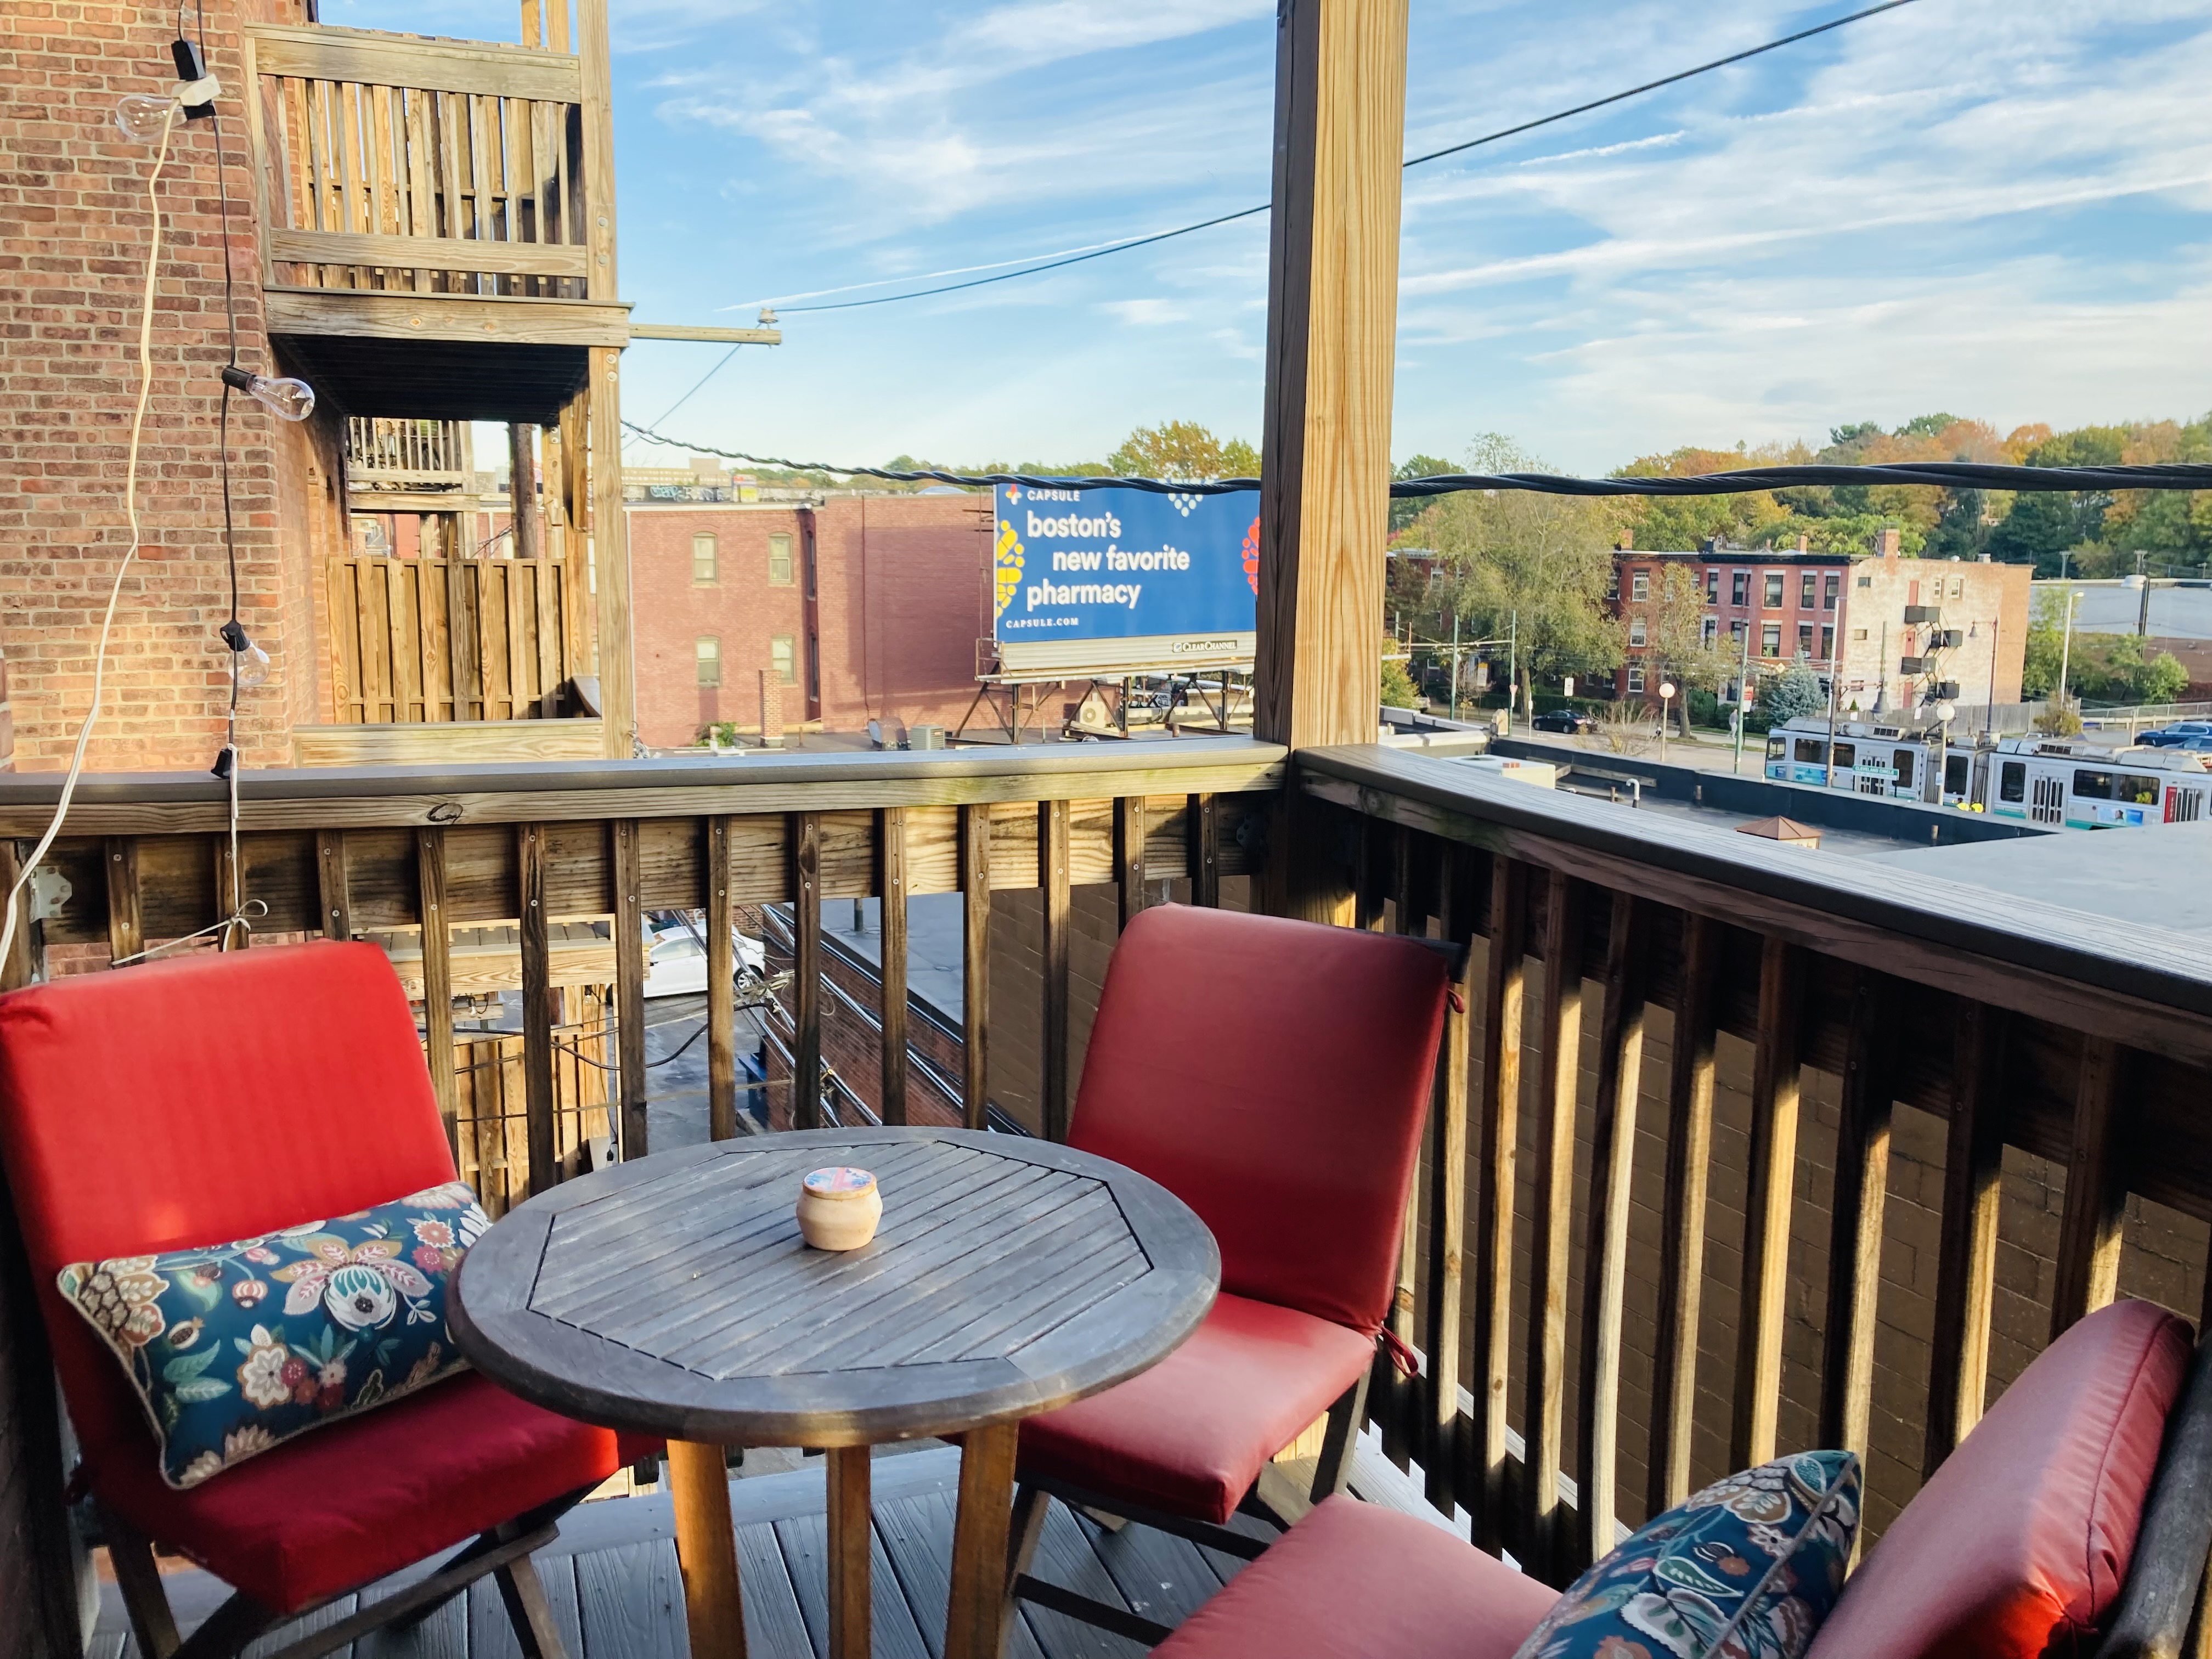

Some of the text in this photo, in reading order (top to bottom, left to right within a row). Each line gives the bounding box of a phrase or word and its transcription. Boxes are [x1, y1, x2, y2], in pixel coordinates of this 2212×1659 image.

[1027, 489, 1080, 501] CAPSULE
[1027, 510, 1121, 538] boston's
[1053, 544, 1190, 571] new favorite
[1027, 578, 1141, 612] pharmacy
[1006, 617, 1079, 629] CAPSULE.COM
